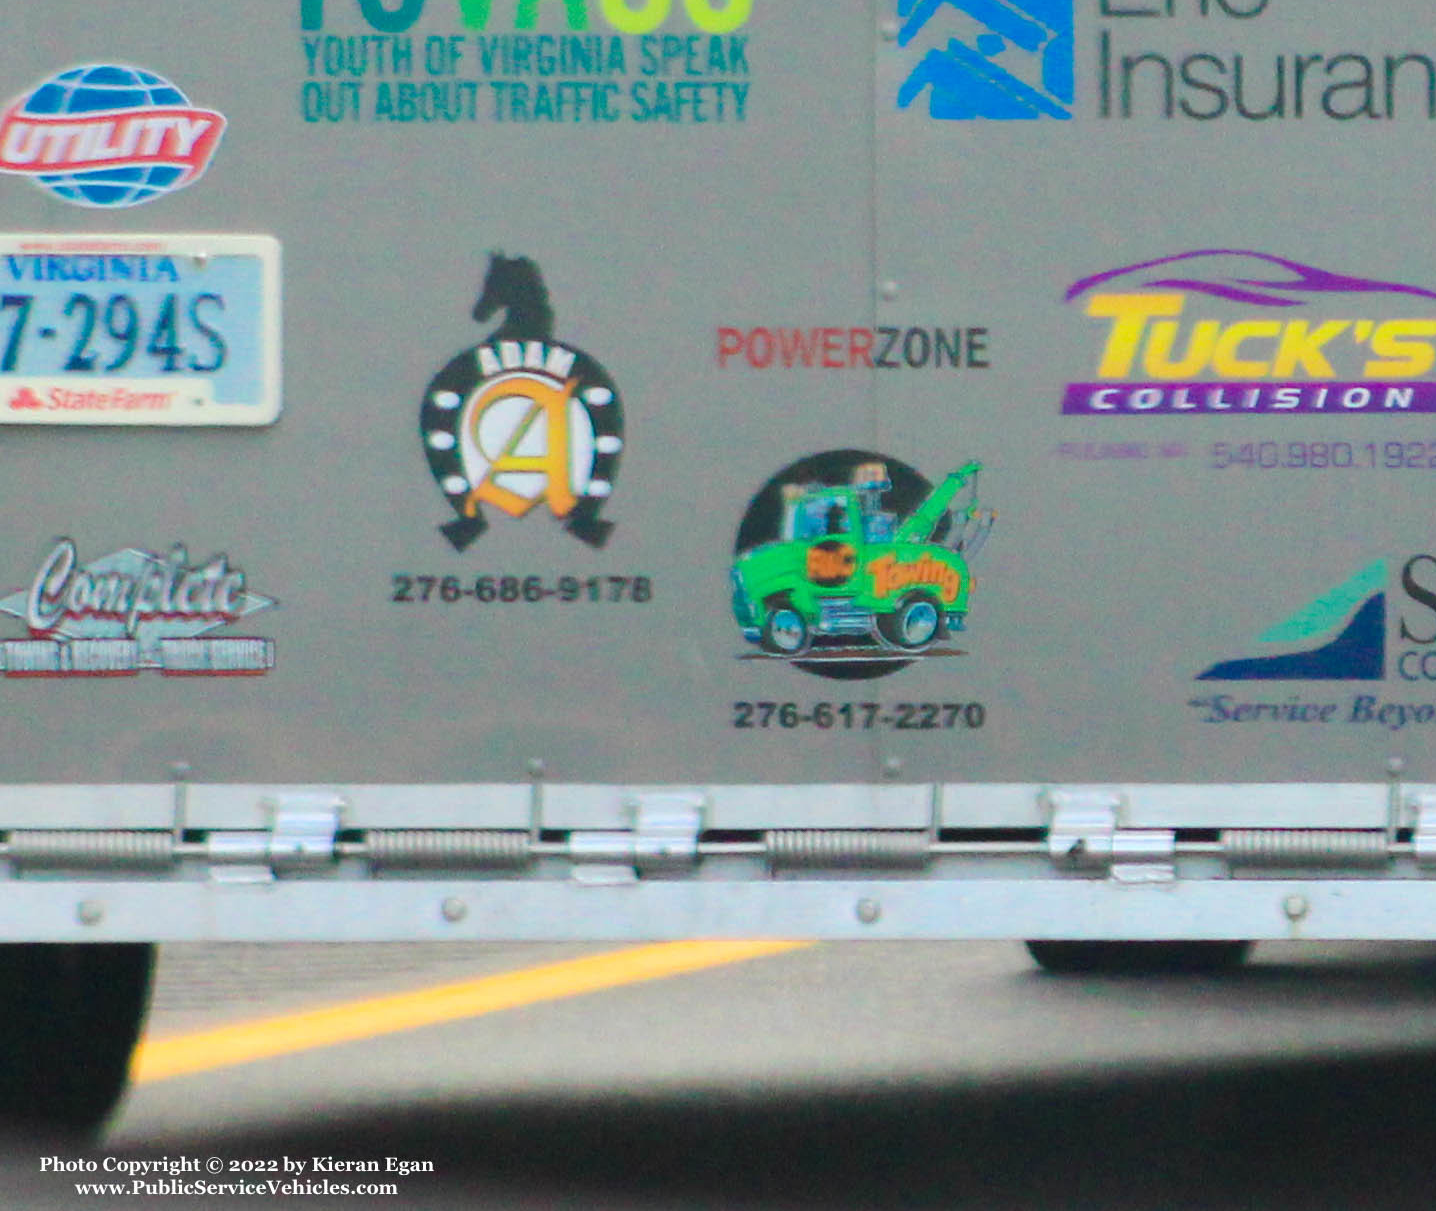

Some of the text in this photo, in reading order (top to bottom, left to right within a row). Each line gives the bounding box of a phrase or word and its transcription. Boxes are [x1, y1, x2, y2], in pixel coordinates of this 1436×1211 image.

[302, 34, 750, 77] YOUTH OF VIRGINIA SPEAK
[302, 80, 751, 123] OUT ABOUT TRAFFIC SAFETY
[3, 117, 212, 164] UTILITY
[4, 255, 180, 282] VIRGINIA
[717, 326, 989, 370] POWERZONE
[1088, 387, 1415, 410] COLLISION
[464, 374, 580, 518] A
[390, 577, 653, 604] 276-686-9178
[733, 702, 985, 730] 276-617-2270
